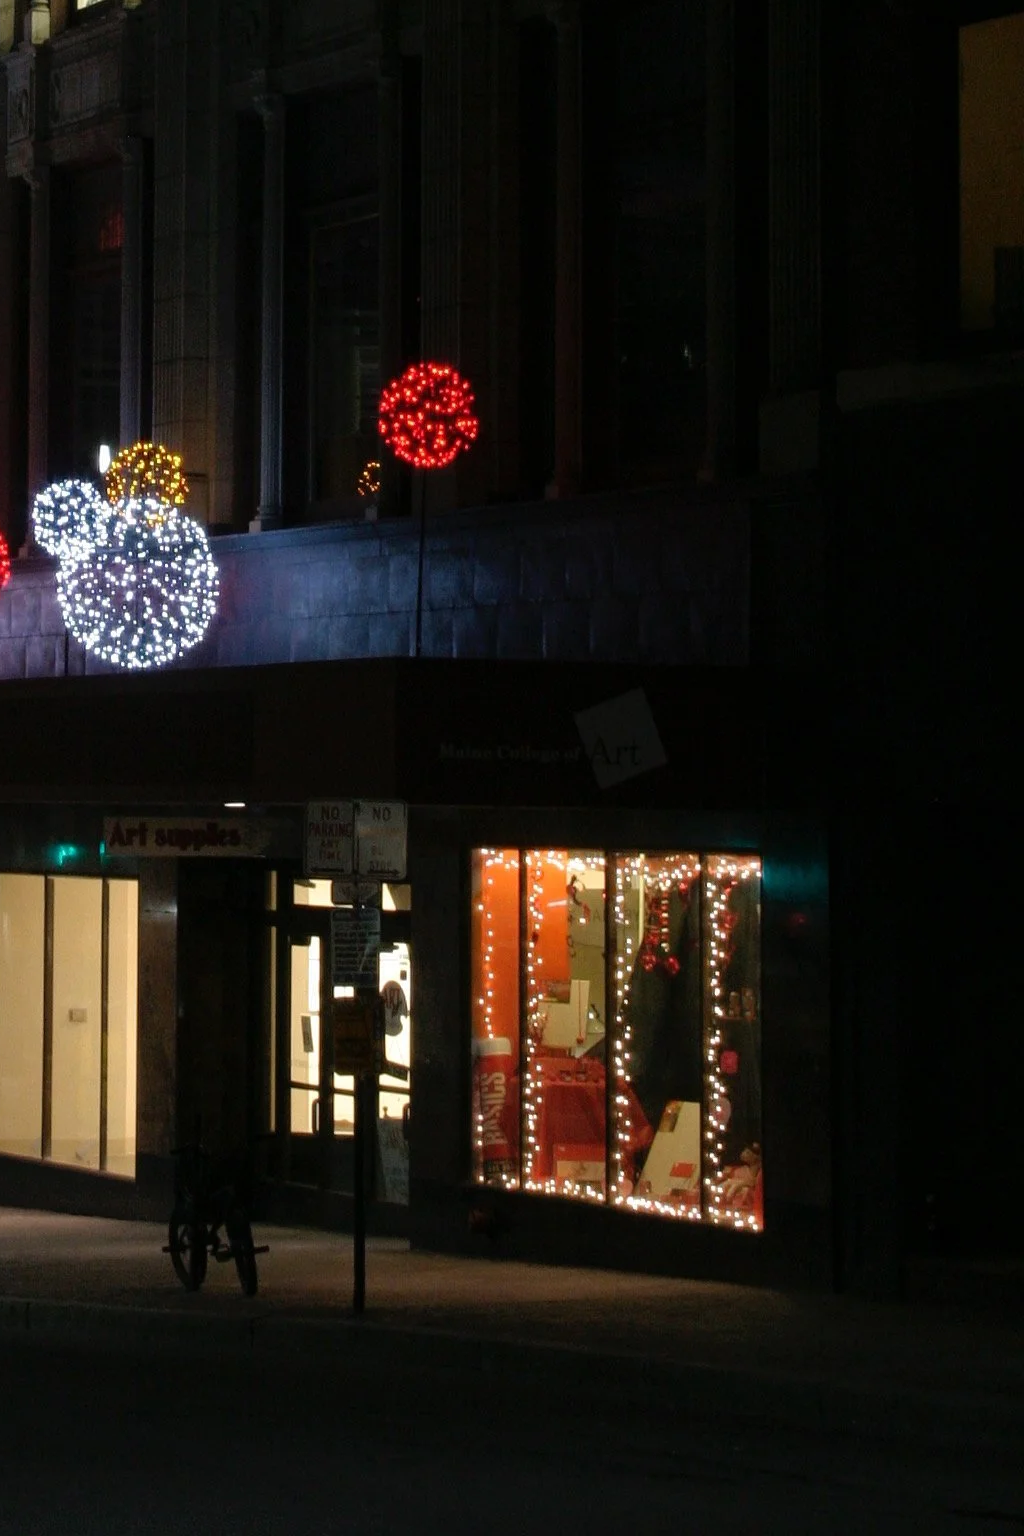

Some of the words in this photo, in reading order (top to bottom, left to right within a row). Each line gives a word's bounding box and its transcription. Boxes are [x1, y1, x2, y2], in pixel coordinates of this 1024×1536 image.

[439, 741, 492, 760] Maine
[496, 743, 560, 763] College
[563, 743, 583, 761] of
[590, 735, 641, 765] Art
[321, 806, 340, 820] NO
[373, 807, 392, 822] NO
[109, 821, 148, 847] Art
[155, 821, 241, 851] supplies
[309, 823, 353, 838] PARKING
[481, 1072, 506, 1145] BASICS
